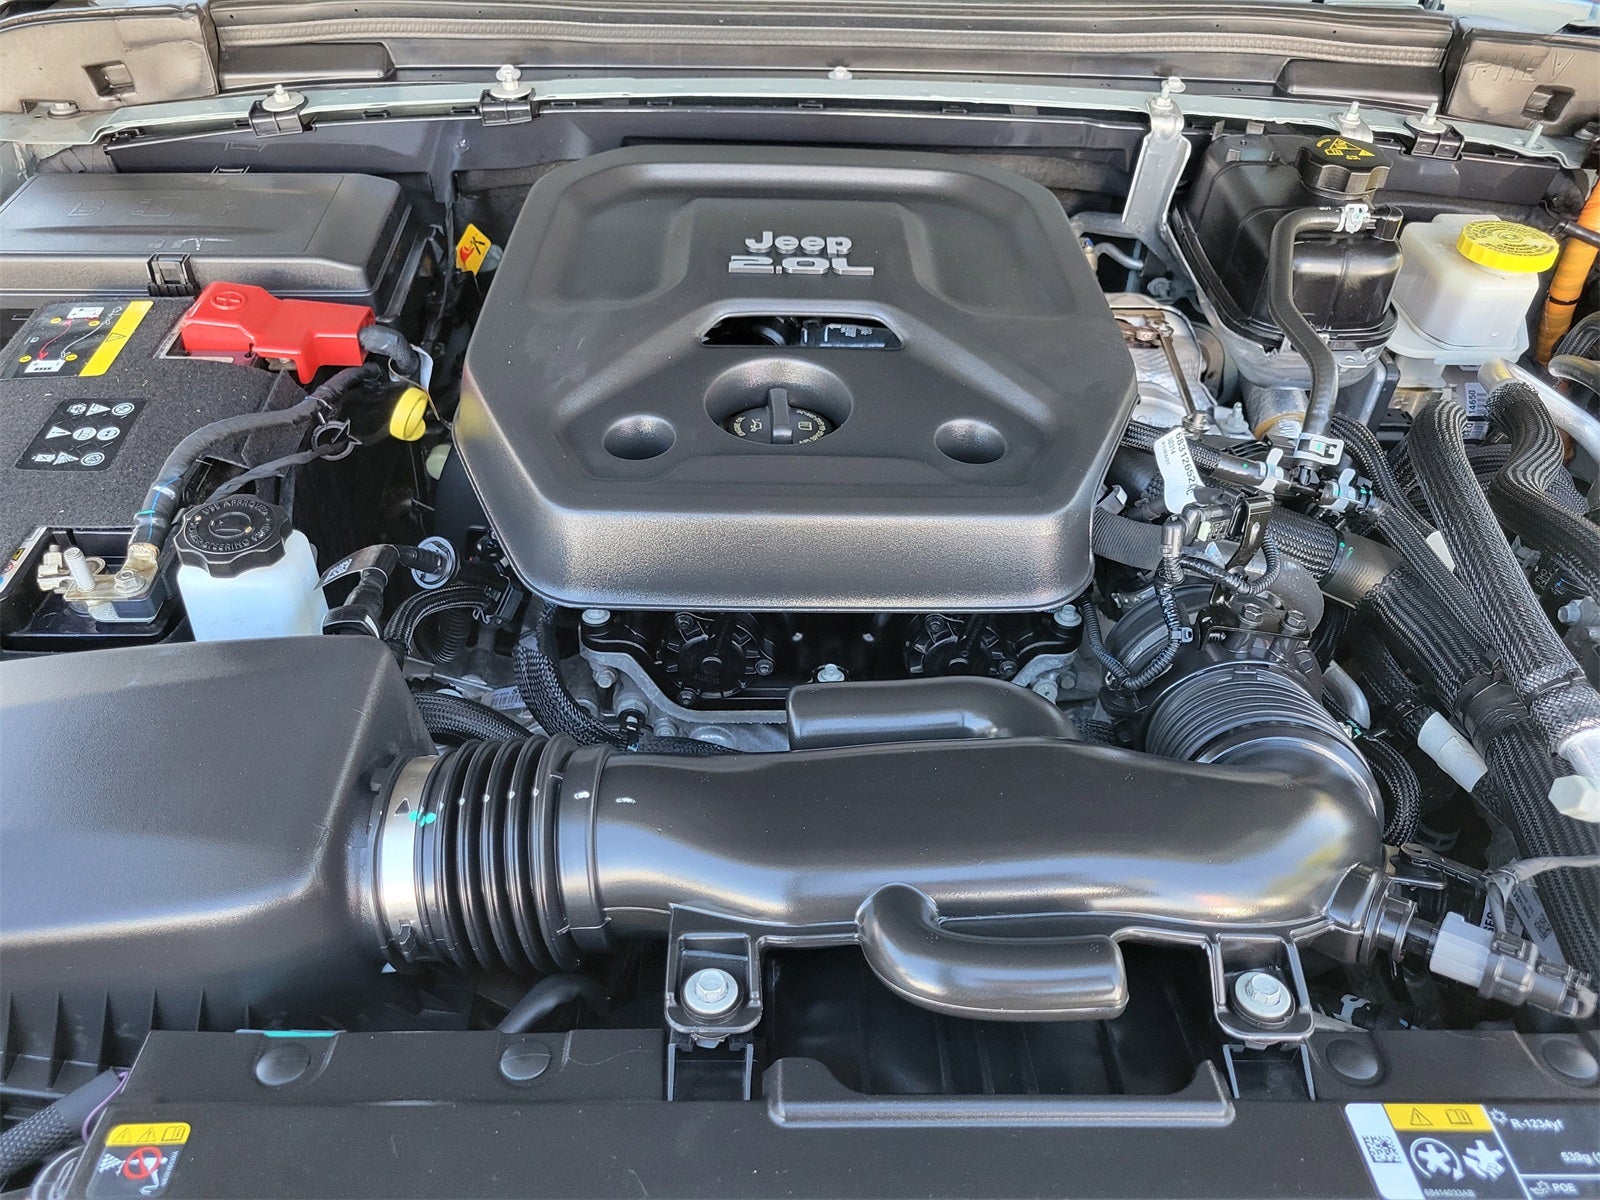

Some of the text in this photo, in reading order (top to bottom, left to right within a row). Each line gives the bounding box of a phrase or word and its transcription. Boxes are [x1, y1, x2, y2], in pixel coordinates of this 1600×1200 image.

[744, 231, 852, 257] Jeep
[728, 255, 875, 276] 2.0L
[1468, 389, 1477, 414] 14650
[1510, 1118, 1564, 1132] R-1234yf
[1551, 1182, 1577, 1193] POE
